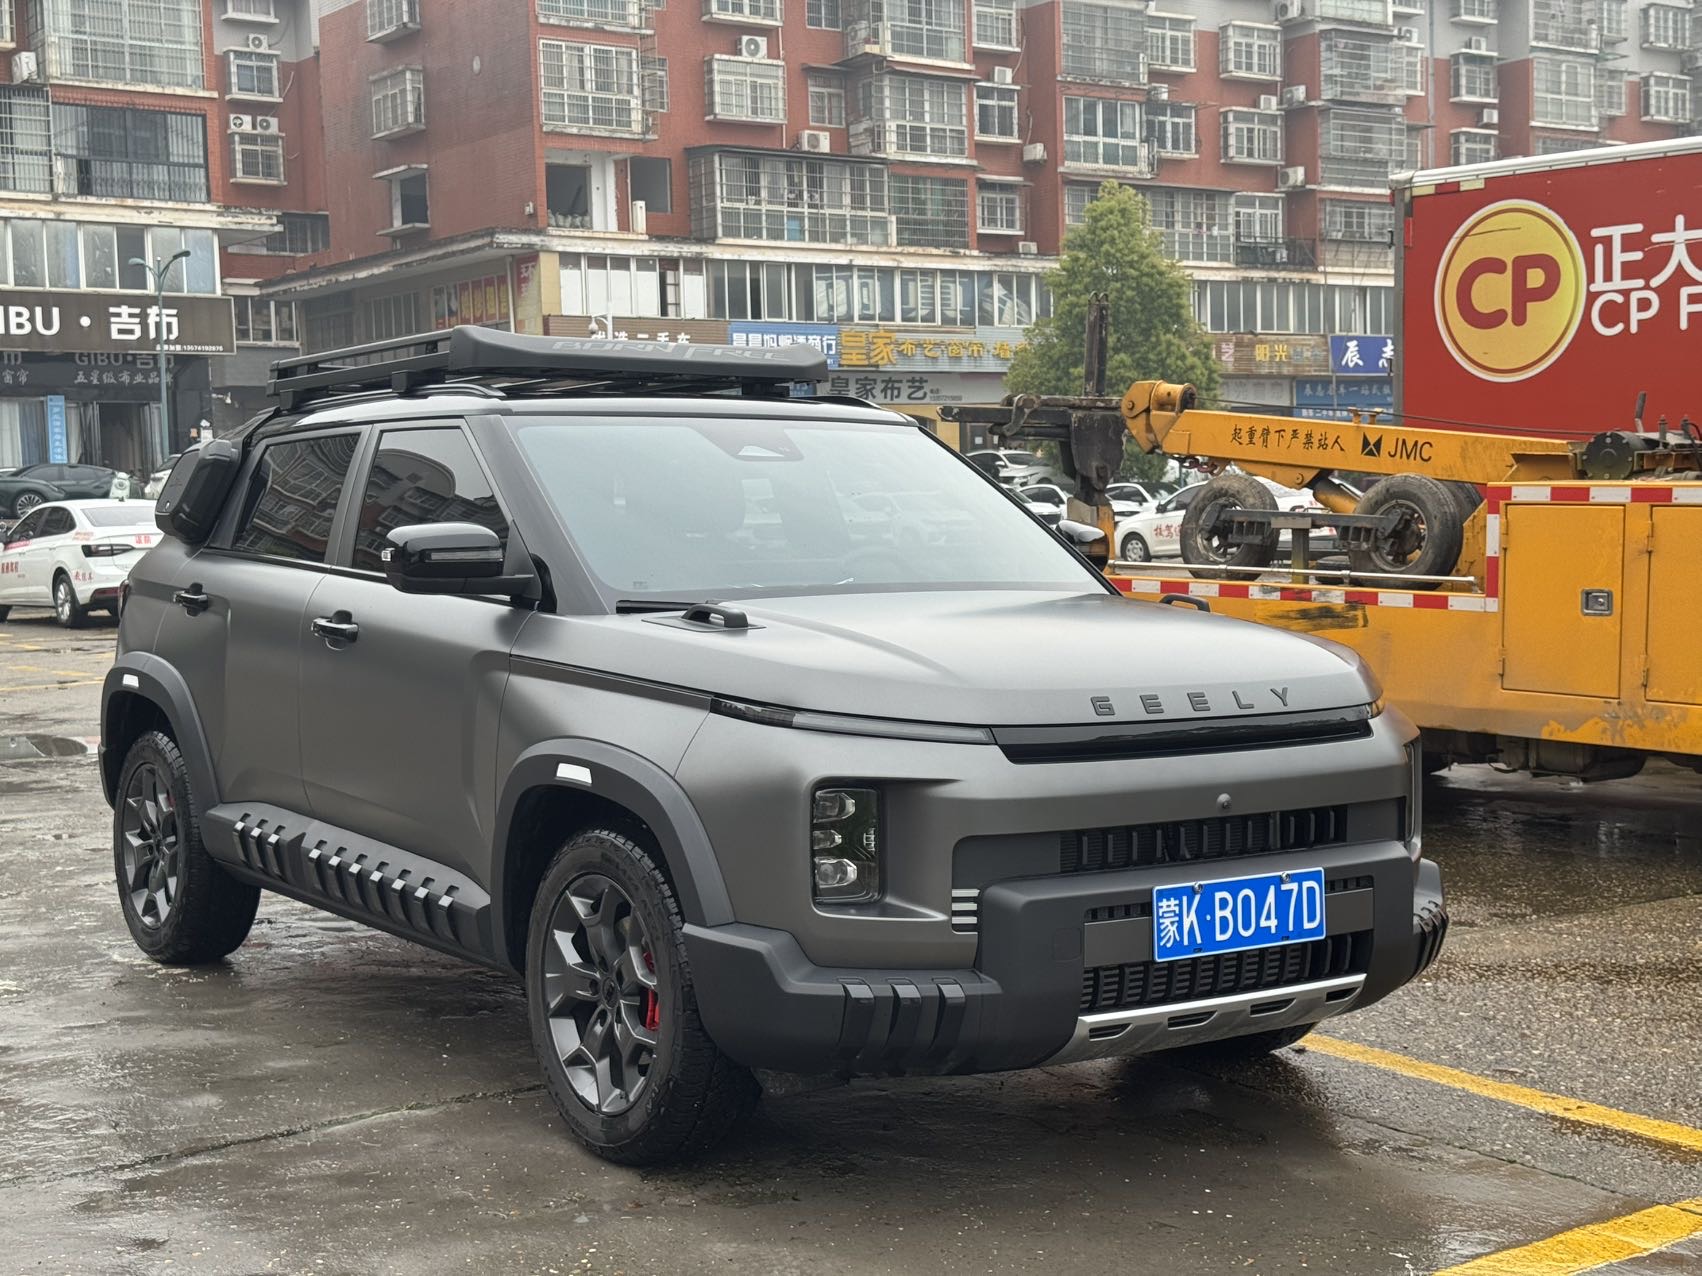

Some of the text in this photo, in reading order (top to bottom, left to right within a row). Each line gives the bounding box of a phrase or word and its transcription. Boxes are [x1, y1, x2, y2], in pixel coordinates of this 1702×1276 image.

[1589, 214, 1702, 293] 正大
[1456, 253, 1561, 330] CP
[109, 305, 179, 340] 吉布
[1591, 290, 1660, 336] CP
[829, 376, 929, 401] 皇家布艺
[1230, 424, 1346, 453] 起重臂下严禁站人
[1388, 436, 1434, 463] JMC
[1090, 686, 1289, 717] GEELY
